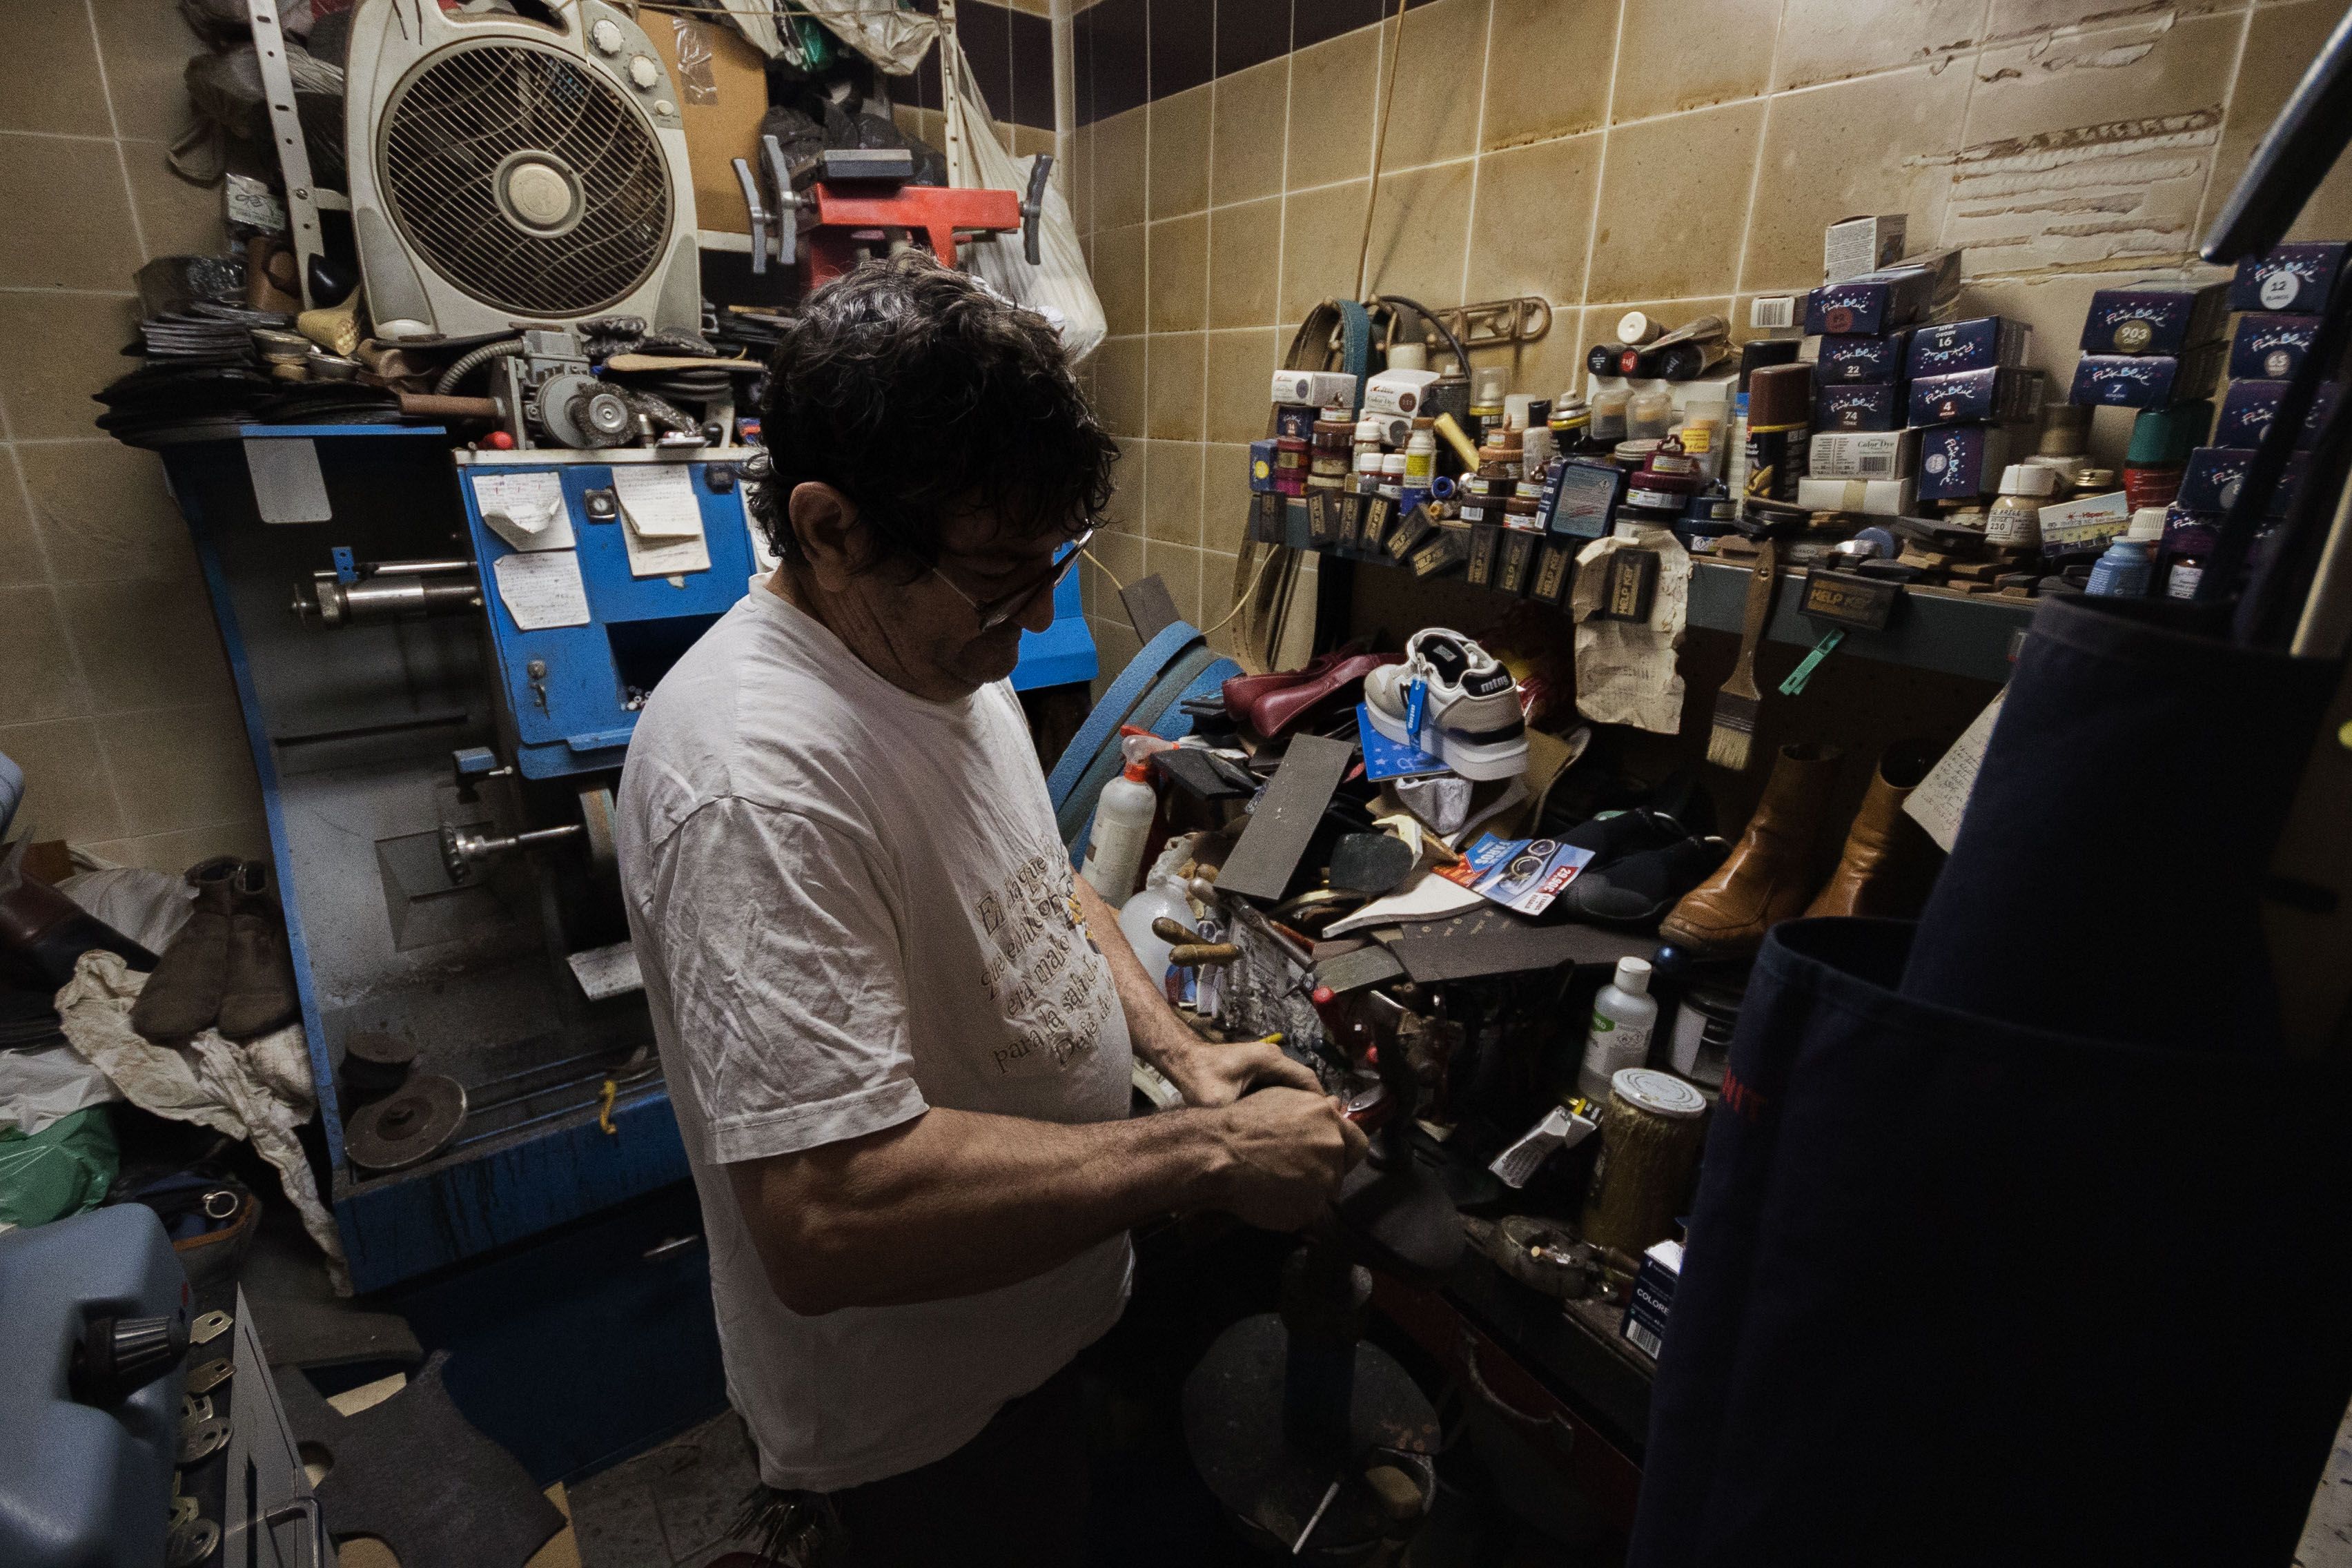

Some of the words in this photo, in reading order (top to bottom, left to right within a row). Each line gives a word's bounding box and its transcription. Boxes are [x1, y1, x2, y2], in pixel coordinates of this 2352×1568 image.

[2271, 280, 2287, 291] 12
[2121, 326, 2148, 340] 903
[1847, 365, 1860, 373] 22
[2113, 384, 2122, 393] 7
[1943, 401, 1952, 411] 4
[1845, 411, 1858, 421] 74
[1808, 589, 1845, 606] HELP
[977, 890, 1006, 937] El
[1017, 856, 1048, 896] que
[1034, 932, 1070, 987] malo
[980, 954, 1008, 1002] que
[993, 1028, 1046, 1075] para
[1037, 1008, 1066, 1037] la
